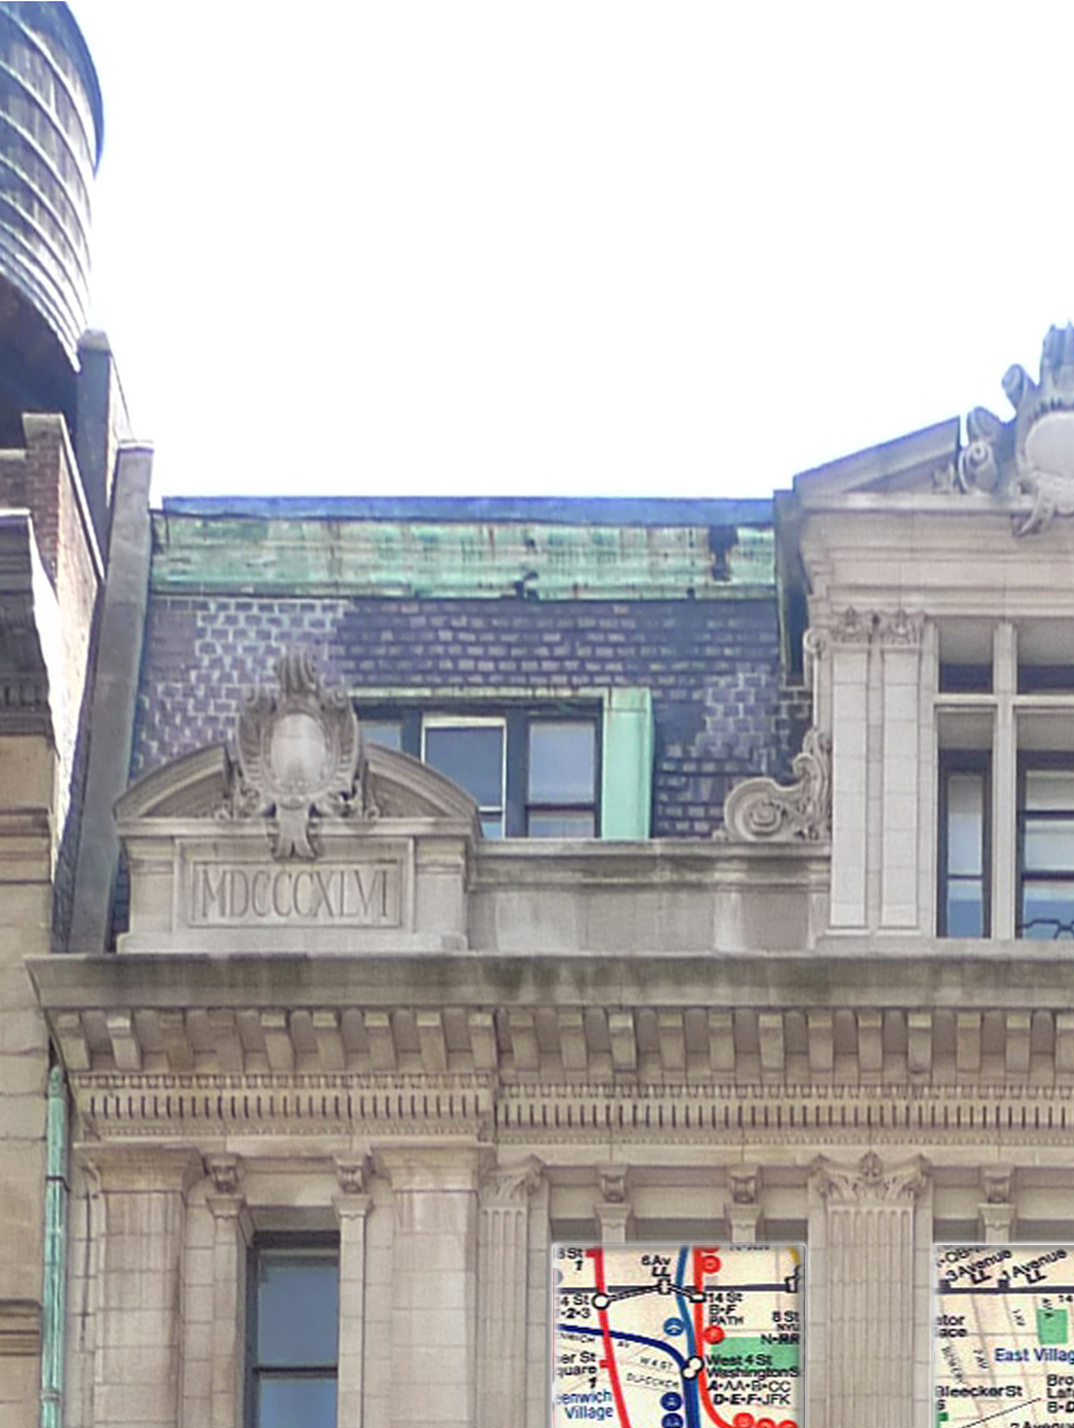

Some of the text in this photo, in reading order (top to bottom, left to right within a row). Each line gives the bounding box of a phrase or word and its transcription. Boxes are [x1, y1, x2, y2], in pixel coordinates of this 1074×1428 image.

[202, 869, 387, 918] MDCCCXLVI
[995, 1348, 1029, 1362] East
[565, 1407, 613, 1420] Village
